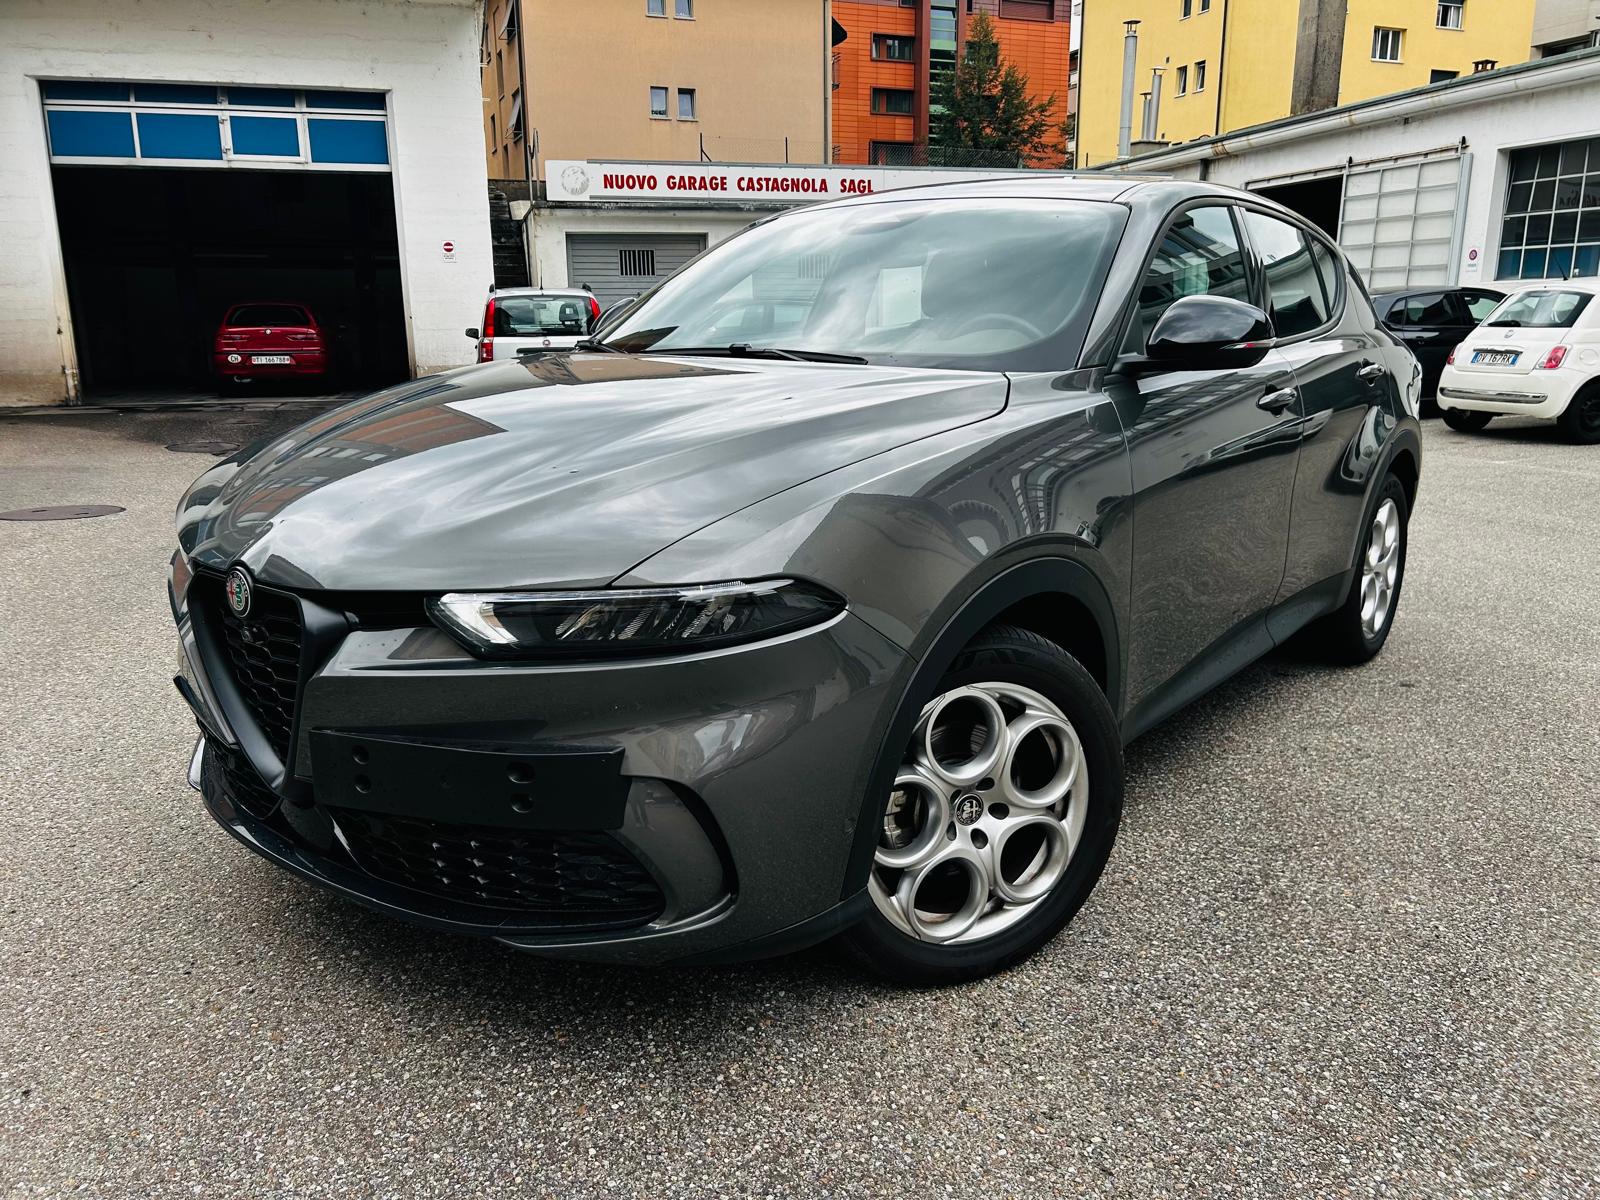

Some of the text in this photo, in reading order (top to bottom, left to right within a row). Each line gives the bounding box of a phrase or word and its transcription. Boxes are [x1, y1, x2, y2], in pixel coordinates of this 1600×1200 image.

[603, 174, 874, 193] NUOVO GARAGE CASTAGNOLA SAGL
